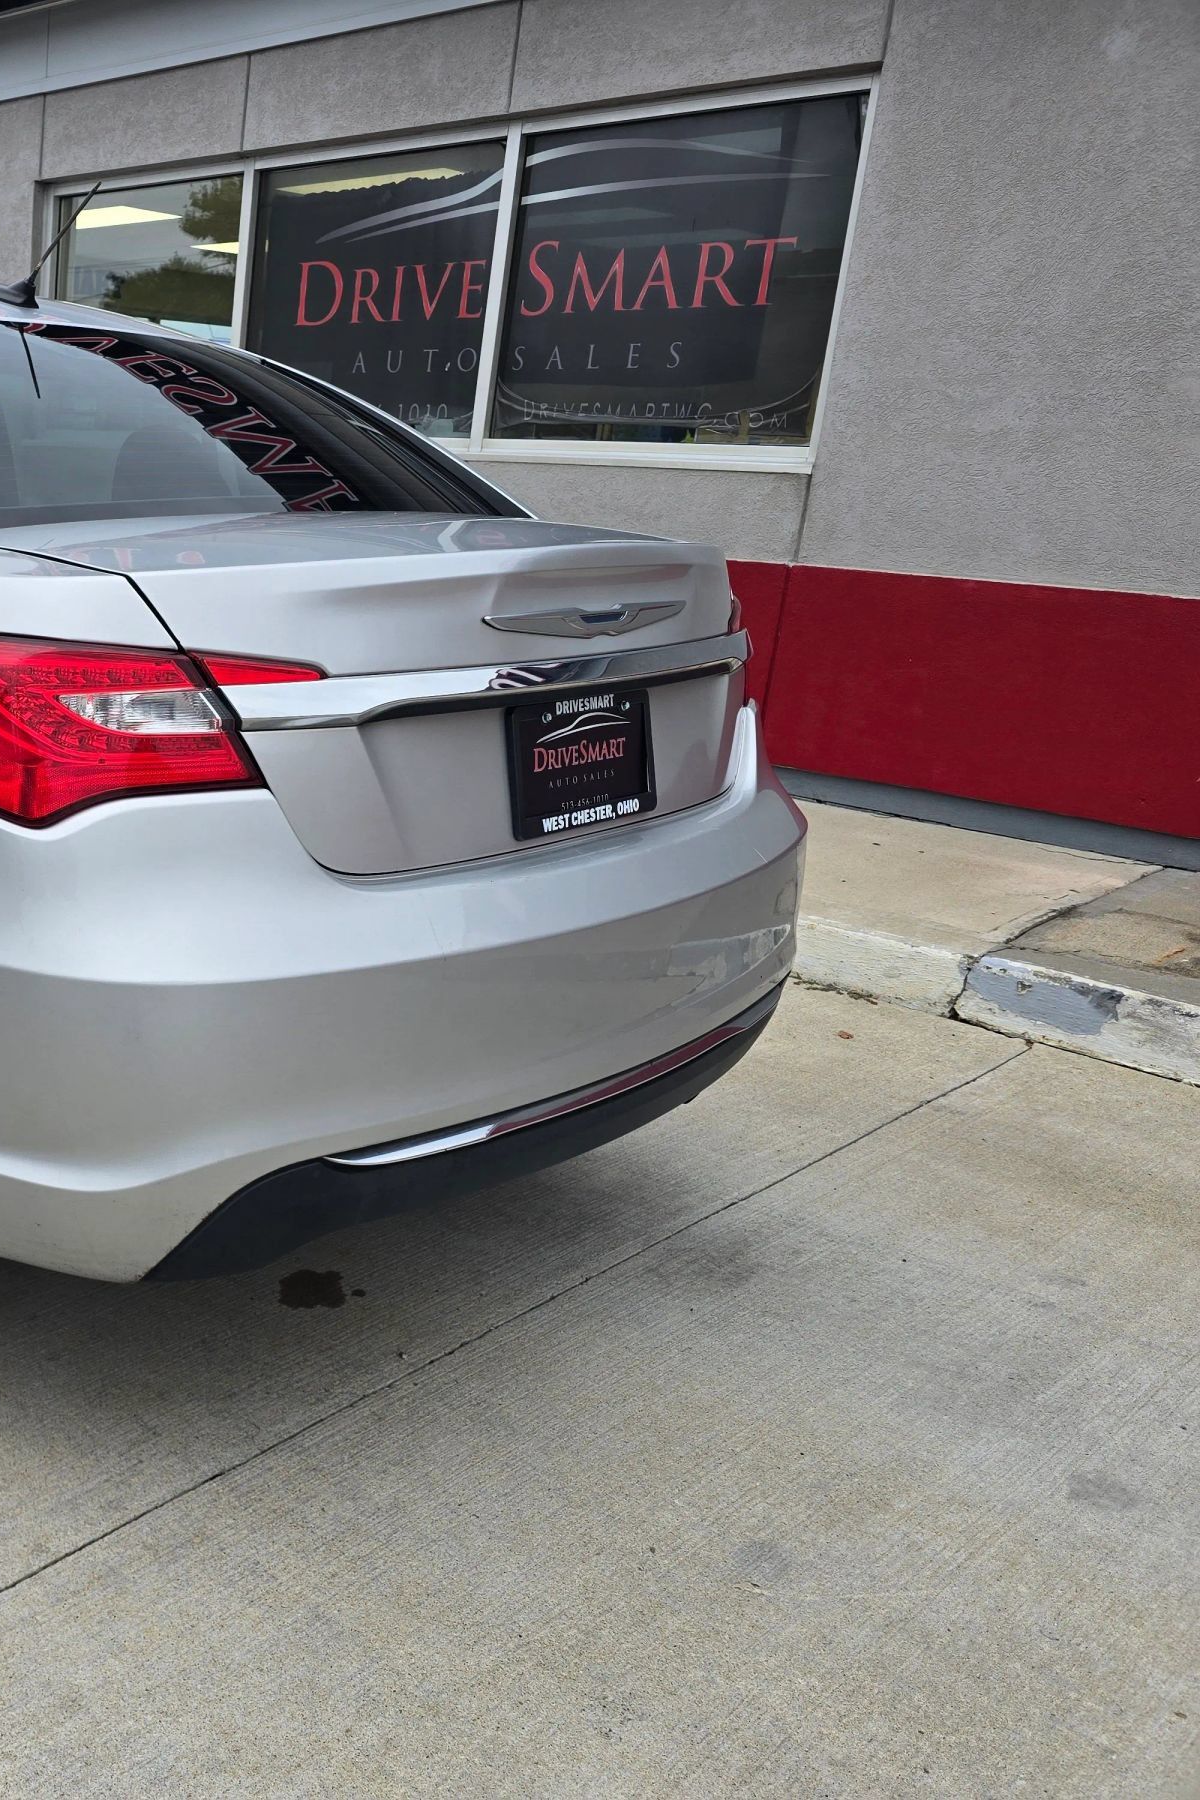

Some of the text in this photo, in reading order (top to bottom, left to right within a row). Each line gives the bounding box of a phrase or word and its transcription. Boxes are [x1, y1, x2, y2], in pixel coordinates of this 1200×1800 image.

[352, 340, 683, 375] AUTO SALES
[555, 693, 615, 716] DRIVESMART
[533, 737, 626, 773] DRIVESMART
[548, 768, 615, 789] AUTO SALES
[542, 798, 640, 833] WEST CHESTER, OHIO
